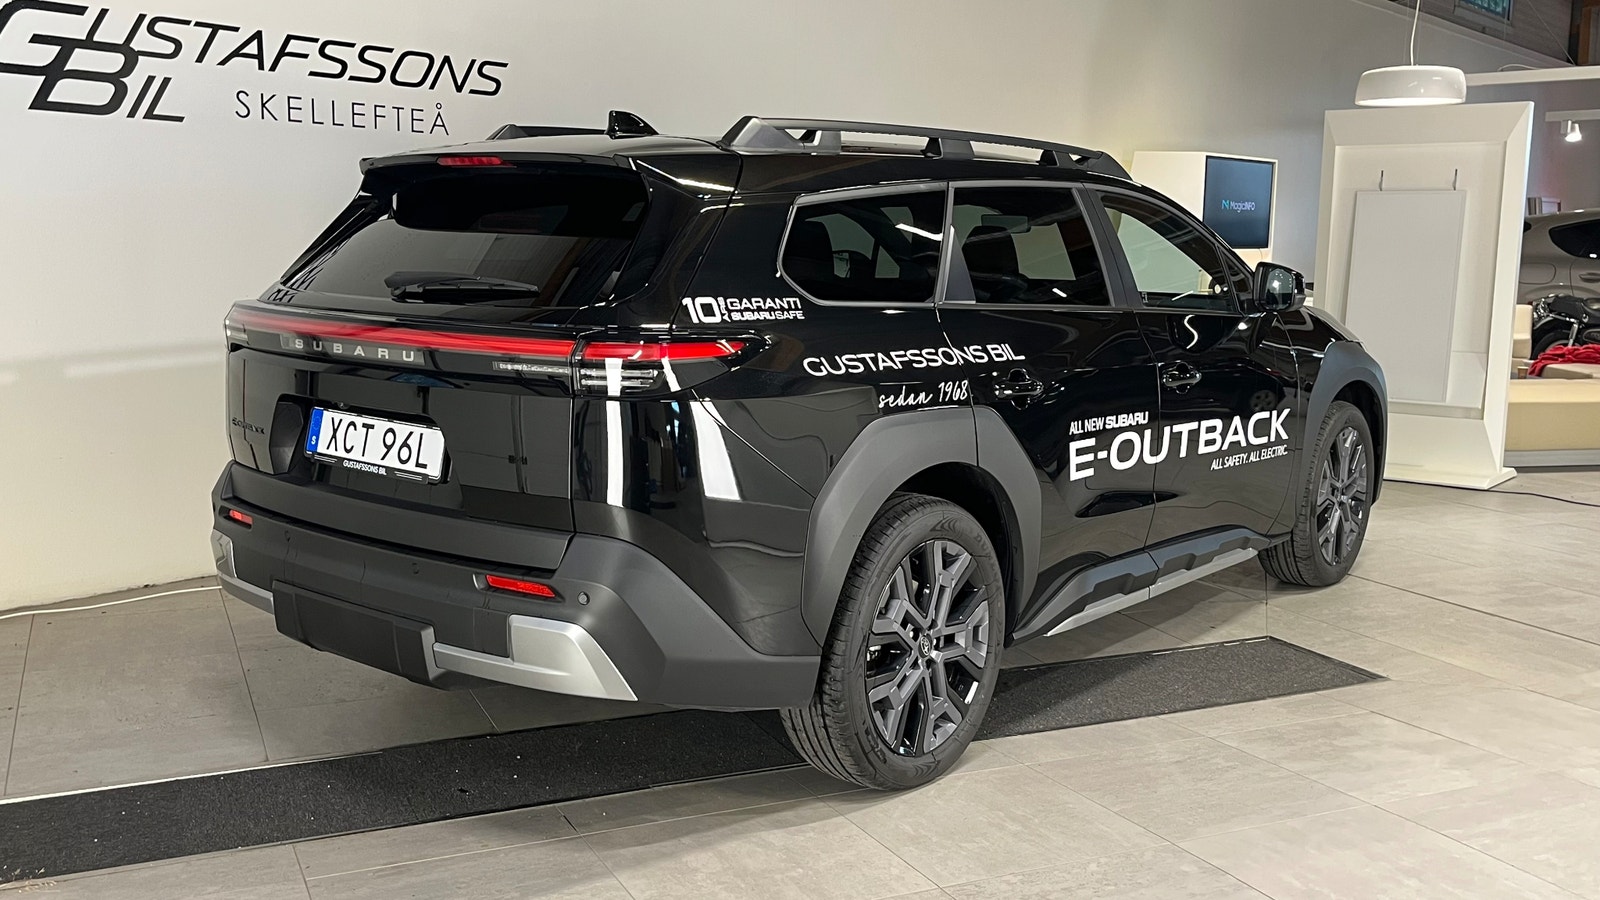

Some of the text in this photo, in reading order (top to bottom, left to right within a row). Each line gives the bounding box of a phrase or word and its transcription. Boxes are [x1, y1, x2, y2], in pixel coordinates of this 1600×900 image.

[0, 0, 509, 97] GUSTAFSSONS
[28, 34, 185, 123] BIL
[235, 90, 449, 136] SKELLEFTEÅ
[682, 296, 722, 324] 10
[726, 297, 802, 310] GARANTI
[294, 338, 415, 362] SUBARU
[802, 343, 1026, 377] GUSTAFSSONS BIL
[878, 379, 969, 409] sedan 1968
[1069, 411, 1149, 436] ALL NEW SUBARU
[311, 435, 317, 445] S
[326, 416, 428, 470] XCT 96L
[1069, 408, 1292, 482] E-OUTBACK
[342, 459, 379, 474] GUSTAFSSONS
[1210, 444, 1289, 471] ALL SAFETY. ALL ELECTRIC
